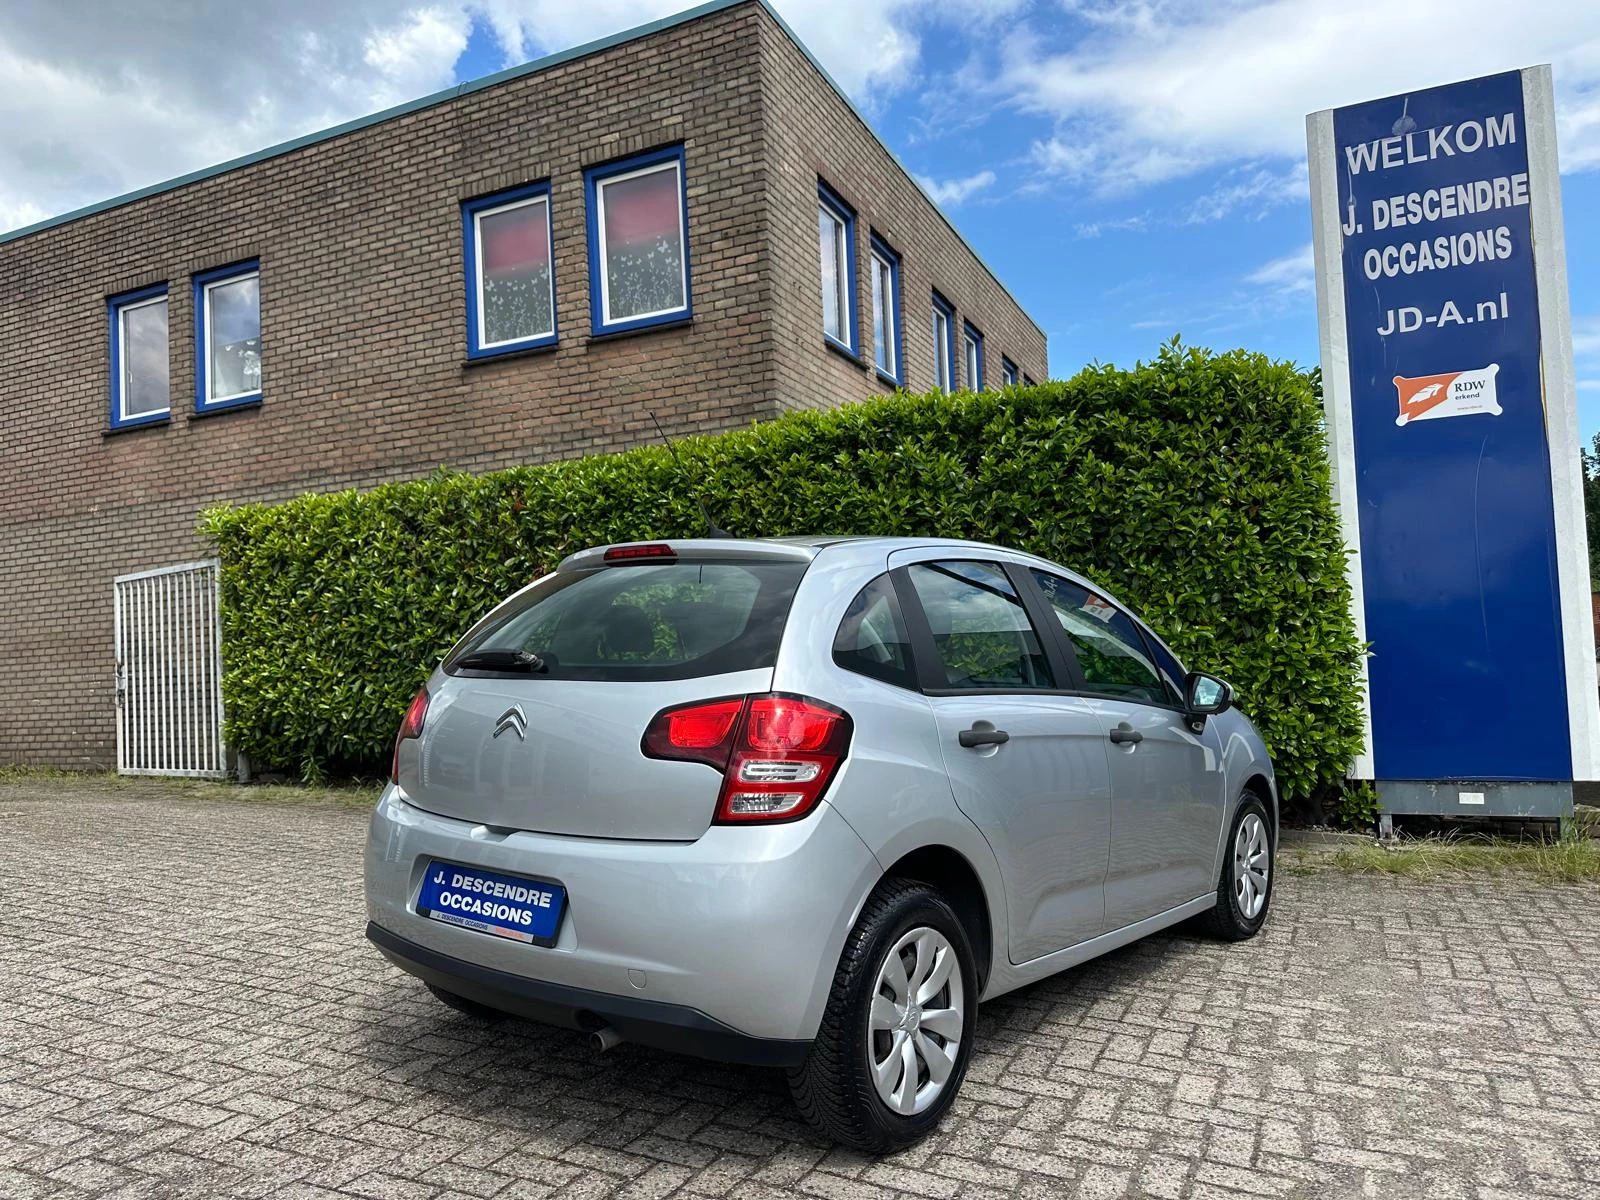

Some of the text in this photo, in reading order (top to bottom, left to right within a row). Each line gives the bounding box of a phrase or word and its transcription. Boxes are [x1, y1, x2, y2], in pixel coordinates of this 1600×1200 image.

[1345, 112, 1516, 175] WELKOM
[1342, 173, 1530, 236] J. DESCENDRE
[1363, 226, 1512, 280] OCCASIONS
[1376, 292, 1509, 336] JD-A.nl
[1454, 380, 1486, 393] RDW
[1454, 392, 1480, 401] erkend
[433, 871, 552, 908] J. DESCENDRE
[439, 891, 533, 926] OCCASIONS
